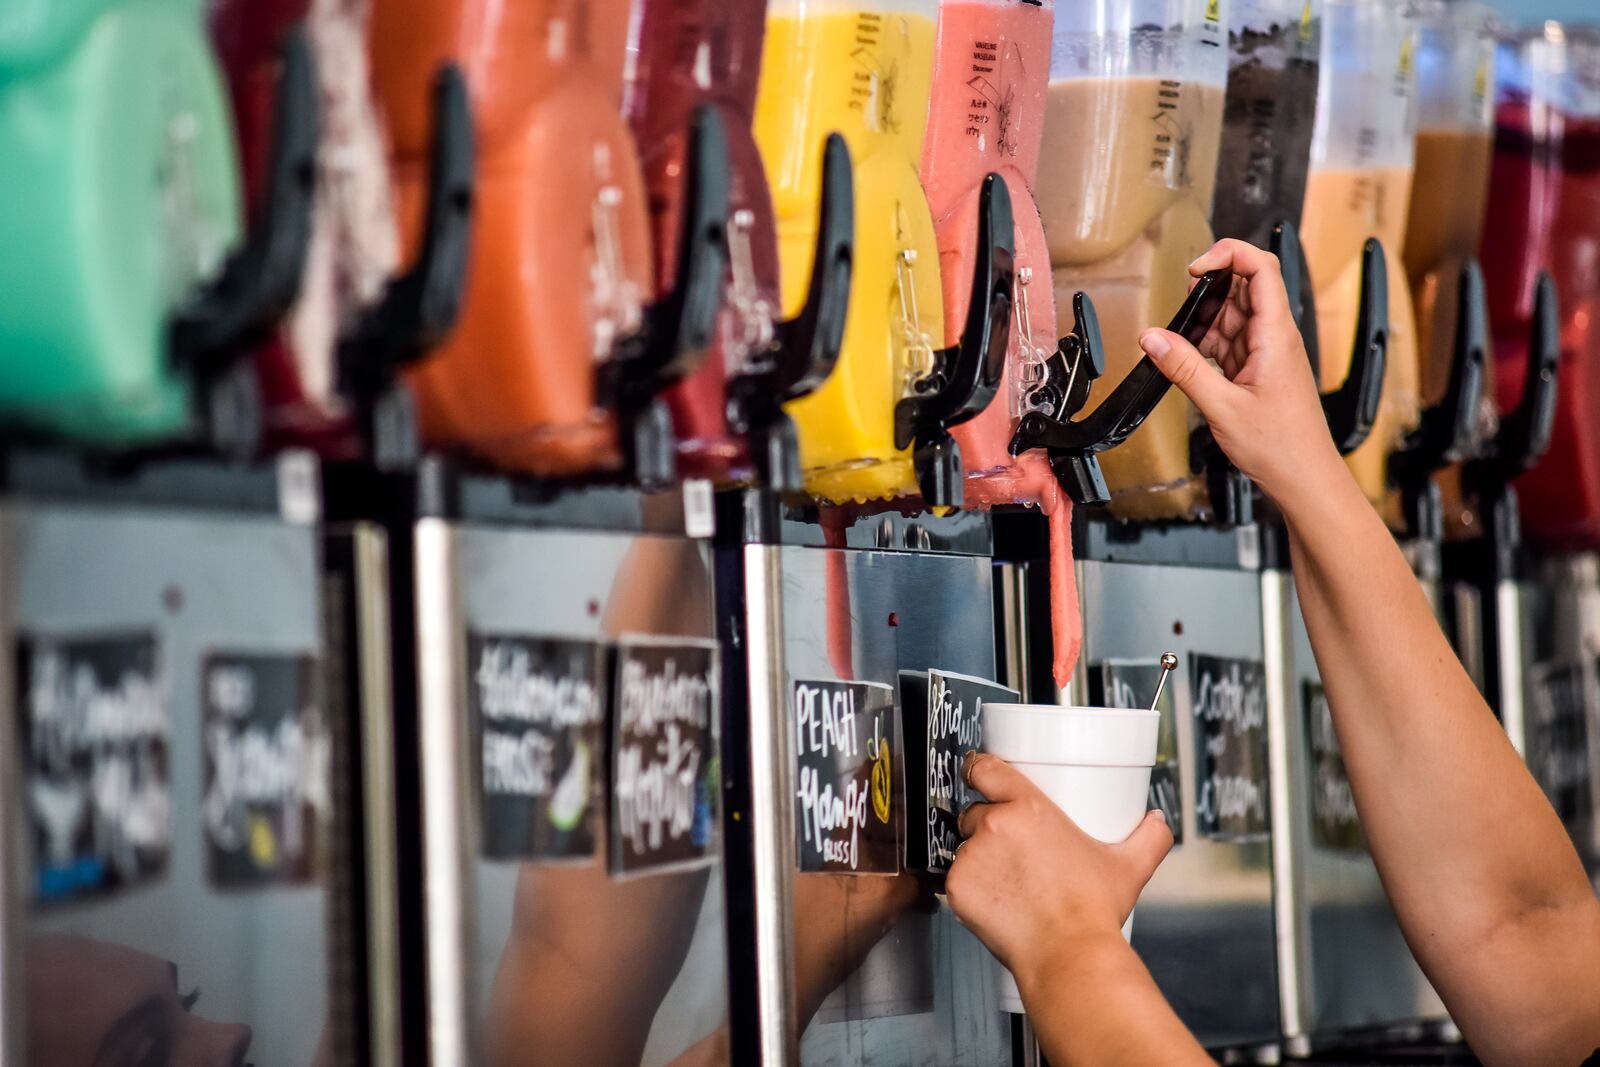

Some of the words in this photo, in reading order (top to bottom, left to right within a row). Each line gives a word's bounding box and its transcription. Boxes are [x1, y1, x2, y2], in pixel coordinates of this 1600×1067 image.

[796, 684, 858, 758] PEACH
[797, 766, 869, 870] Mango
[823, 837, 850, 865] BLISS
